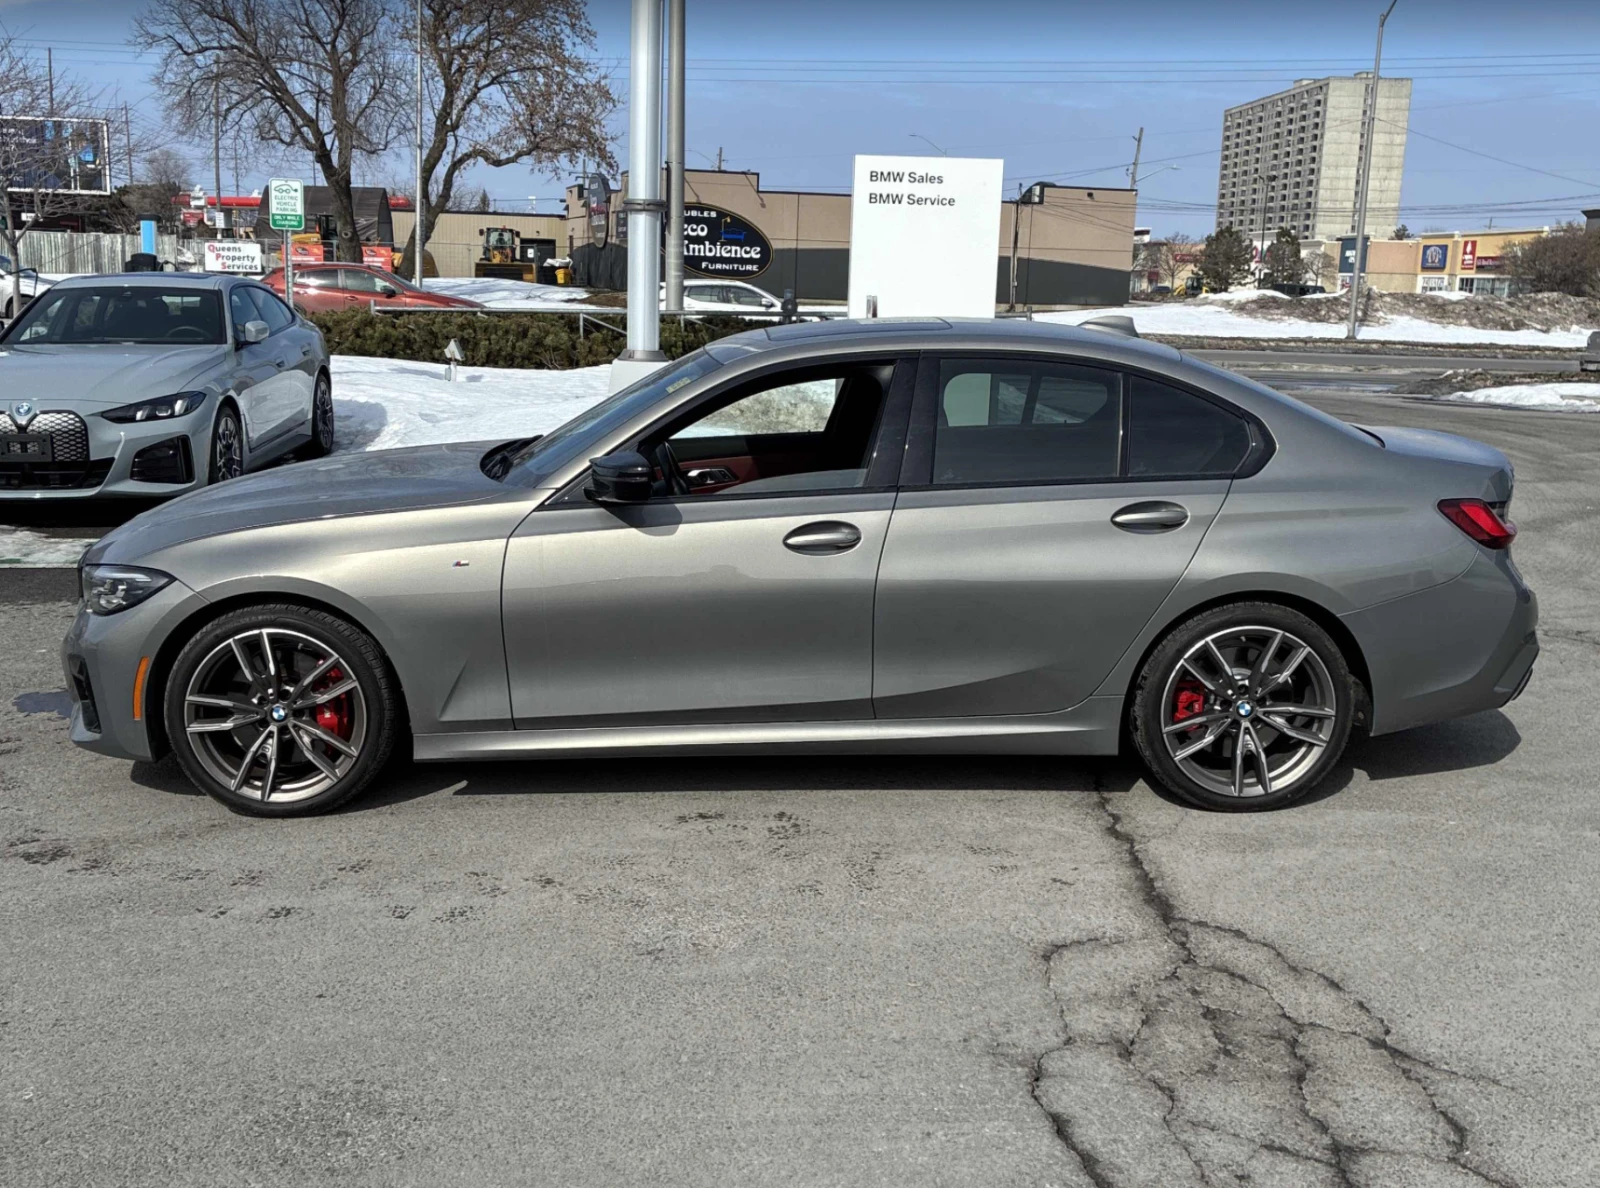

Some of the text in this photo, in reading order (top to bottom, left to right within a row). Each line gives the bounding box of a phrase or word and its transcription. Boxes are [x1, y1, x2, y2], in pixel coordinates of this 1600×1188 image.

[869, 170, 944, 184] BMW Sales
[868, 192, 956, 206] BMW Service
[684, 209, 717, 218] UBLES
[684, 223, 708, 236] co
[207, 244, 242, 253] Queens
[215, 253, 256, 263] Property
[221, 261, 258, 270] Services
[701, 261, 760, 272] FURNITURE
